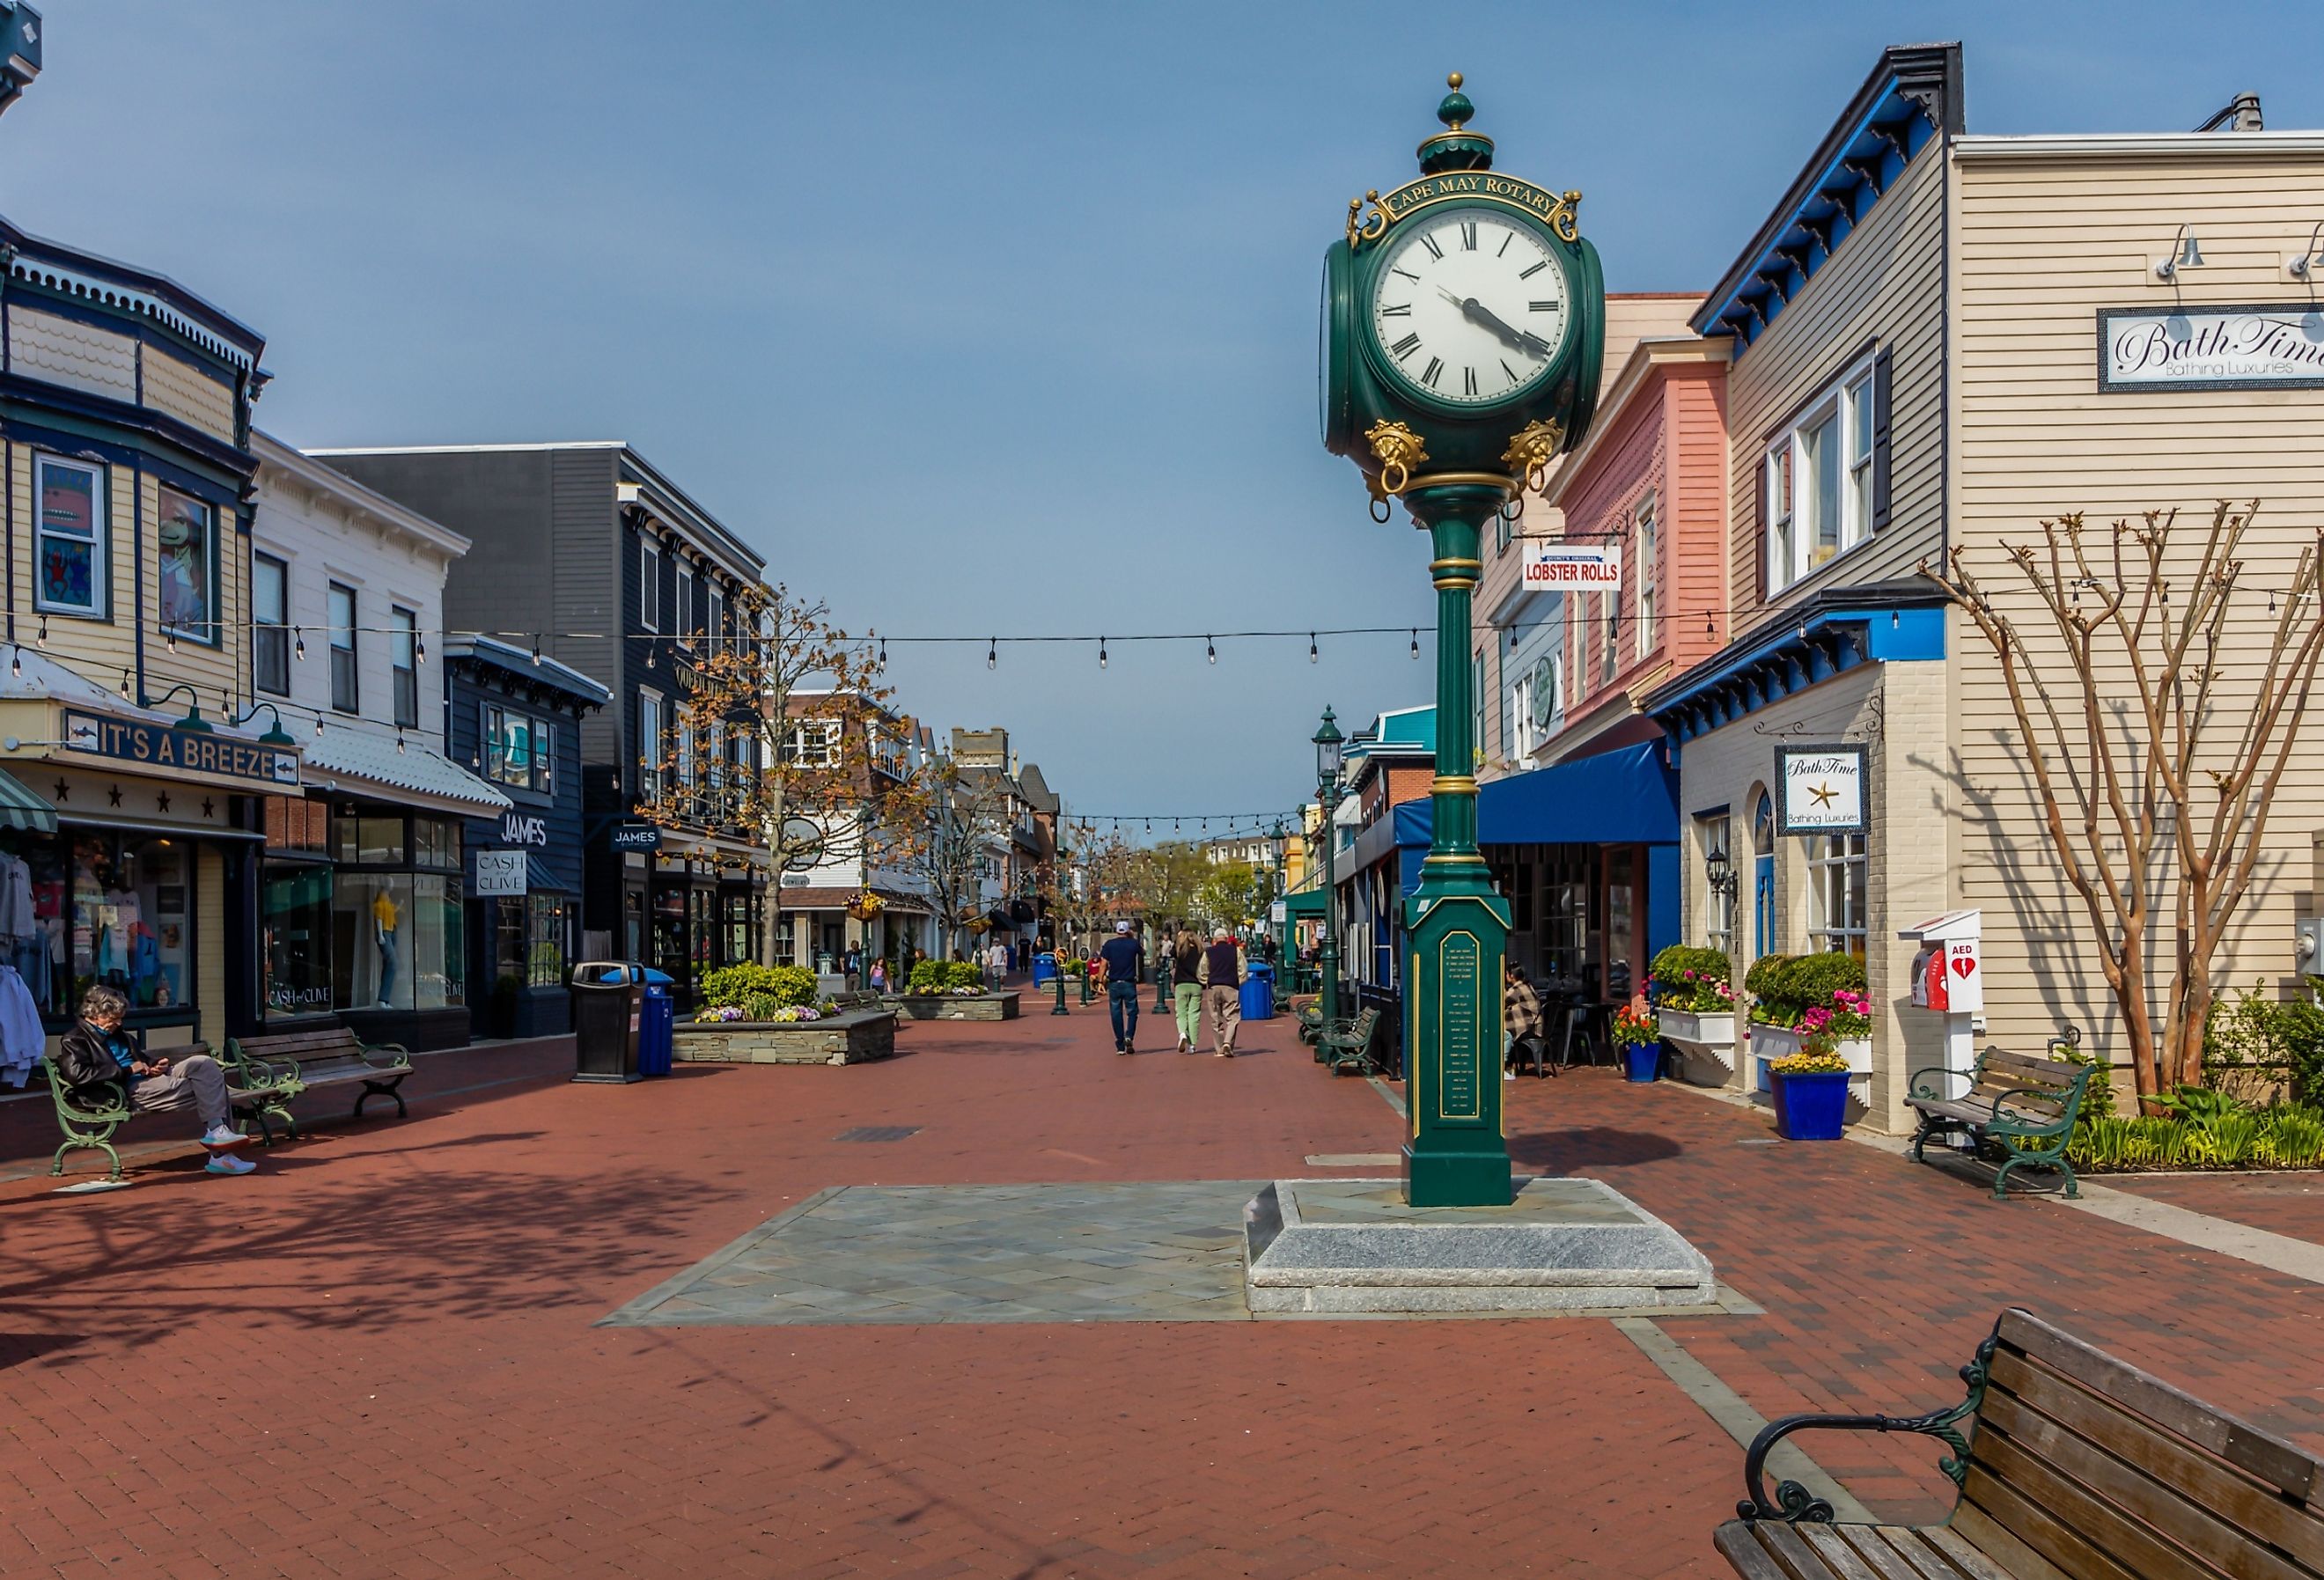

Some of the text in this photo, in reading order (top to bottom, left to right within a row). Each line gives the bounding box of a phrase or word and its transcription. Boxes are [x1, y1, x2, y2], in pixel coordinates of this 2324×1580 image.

[1387, 177, 1557, 213] CAPE MAY ROTARY
[1460, 222, 1478, 252] XII
[1420, 233, 1445, 263] XI
[1392, 264, 1421, 285] X
[1519, 260, 1548, 280] II
[1382, 303, 1411, 316] IX
[1529, 300, 1559, 312] III
[1390, 331, 1423, 362] VIII
[2115, 318, 2230, 374] Bath
[1421, 356, 1445, 388] VII
[1500, 358, 1518, 385] V
[2166, 360, 2294, 377] Bathing Luxuries
[1465, 366, 1478, 395] VI
[1526, 563, 1617, 581] LOBSTER ROLLS
[101, 722, 273, 778] IT'S A BREEZE
[1787, 757, 1857, 776] Bath Time
[1788, 812, 1858, 825] Bathing Luxuries
[501, 813, 546, 847] JAMES
[615, 832, 656, 842] JAMES
[479, 856, 524, 870] CASH
[479, 877, 522, 890] CLIVE
[1952, 944, 1973, 954] AED
[268, 989, 296, 1005] CASH
[305, 987, 330, 1003] CLIVE
